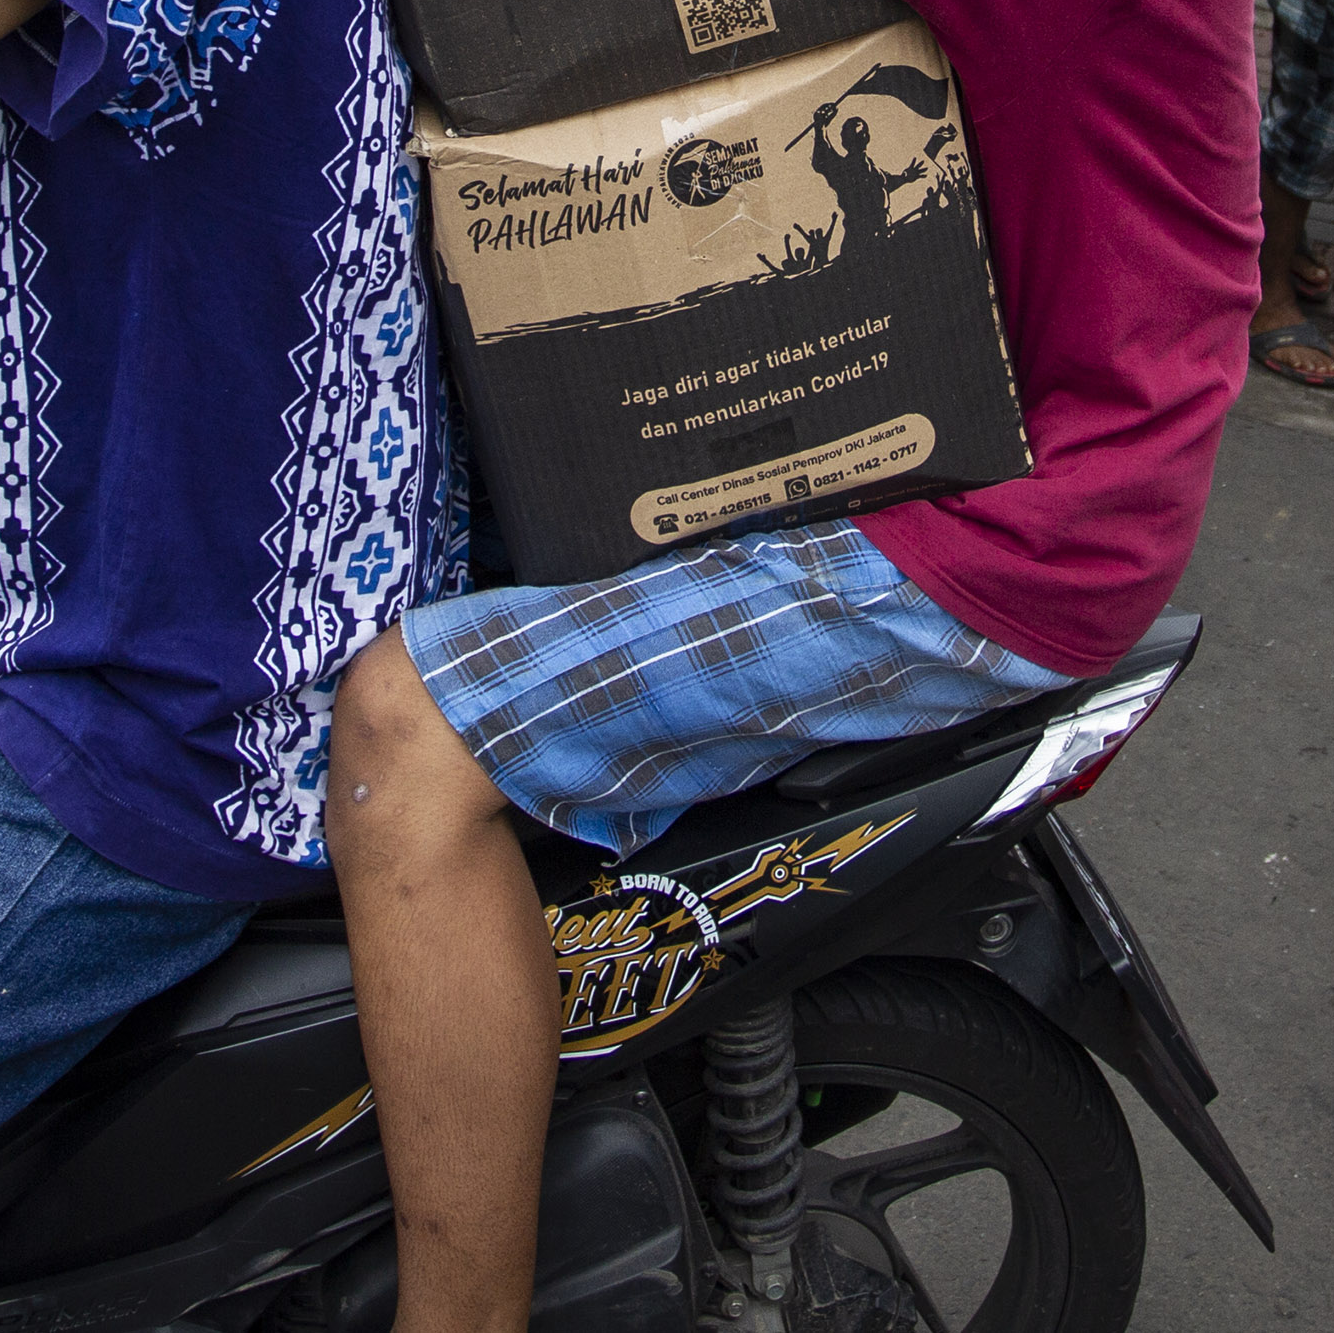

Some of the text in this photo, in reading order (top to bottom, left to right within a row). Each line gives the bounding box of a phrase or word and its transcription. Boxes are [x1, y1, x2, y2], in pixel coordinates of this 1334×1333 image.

[458, 148, 645, 211] Selamat Hari
[705, 137, 759, 165] SEMANGAT
[711, 178, 720, 191] DI
[467, 186, 653, 254] PAHLAWAN
[620, 315, 892, 407] Jaga diri agar tidak tertular
[640, 351, 889, 440] dan menularkan Covid-19
[656, 423, 907, 507] Call Center Dinas Sosial Pemprov DKI Jakarta
[813, 471, 843, 488] 0821
[852, 455, 881, 476] 1142
[889, 442, 918, 462] 0717
[683, 510, 708, 525] 021
[719, 493, 772, 517] 4265115
[619, 873, 720, 946] BORN TO RIDE
[557, 942, 698, 1033] EET
